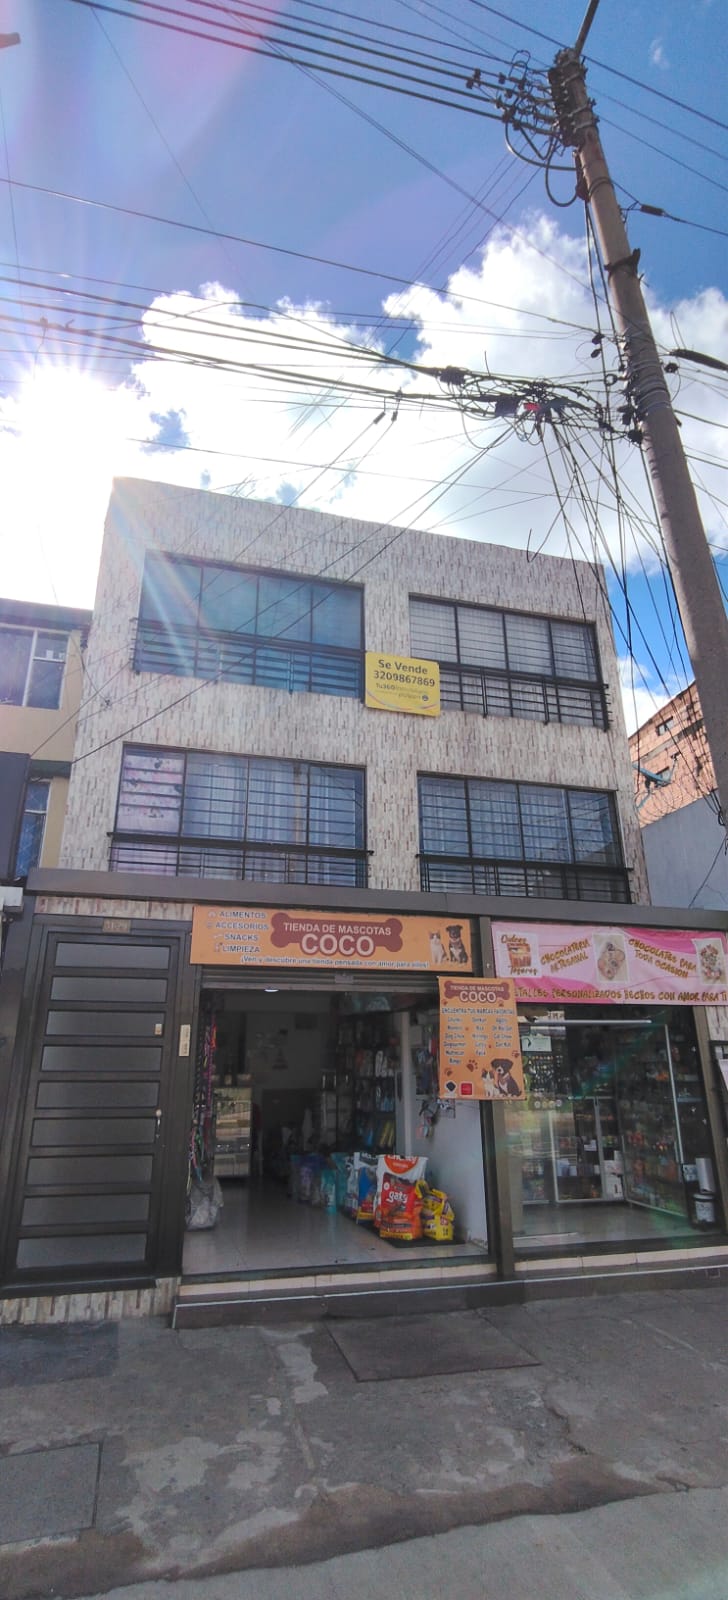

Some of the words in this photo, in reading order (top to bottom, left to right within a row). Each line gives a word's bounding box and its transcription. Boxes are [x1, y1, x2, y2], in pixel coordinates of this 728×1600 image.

[379, 660, 391, 669] Se
[394, 661, 428, 674] Vende
[374, 670, 435, 687] 3209867869
[219, 911, 266, 919] ALIMENTOS
[215, 922, 269, 930] ACCESORIOS
[284, 922, 320, 932] TIENDA
[322, 924, 336, 933] DE
[338, 925, 392, 936] MASCOTAS
[224, 933, 259, 941] SNACKS
[222, 945, 260, 953] LIMPIEZA
[301, 933, 375, 956] COCO
[264, 956, 297, 964] descubre
[312, 957, 334, 965] tienda
[335, 959, 363, 967] pensada
[628, 938, 677, 963] CHOCOLATES
[679, 958, 697, 971] PARA
[635, 949, 653, 964] TODA
[460, 991, 497, 1003] COCO
[552, 988, 622, 999] PERSONALIZADOS
[624, 988, 655, 1000] HECHOS
[658, 991, 676, 1000] CON
[677, 991, 700, 1002] AMOR
[701, 991, 719, 1001] PARA
